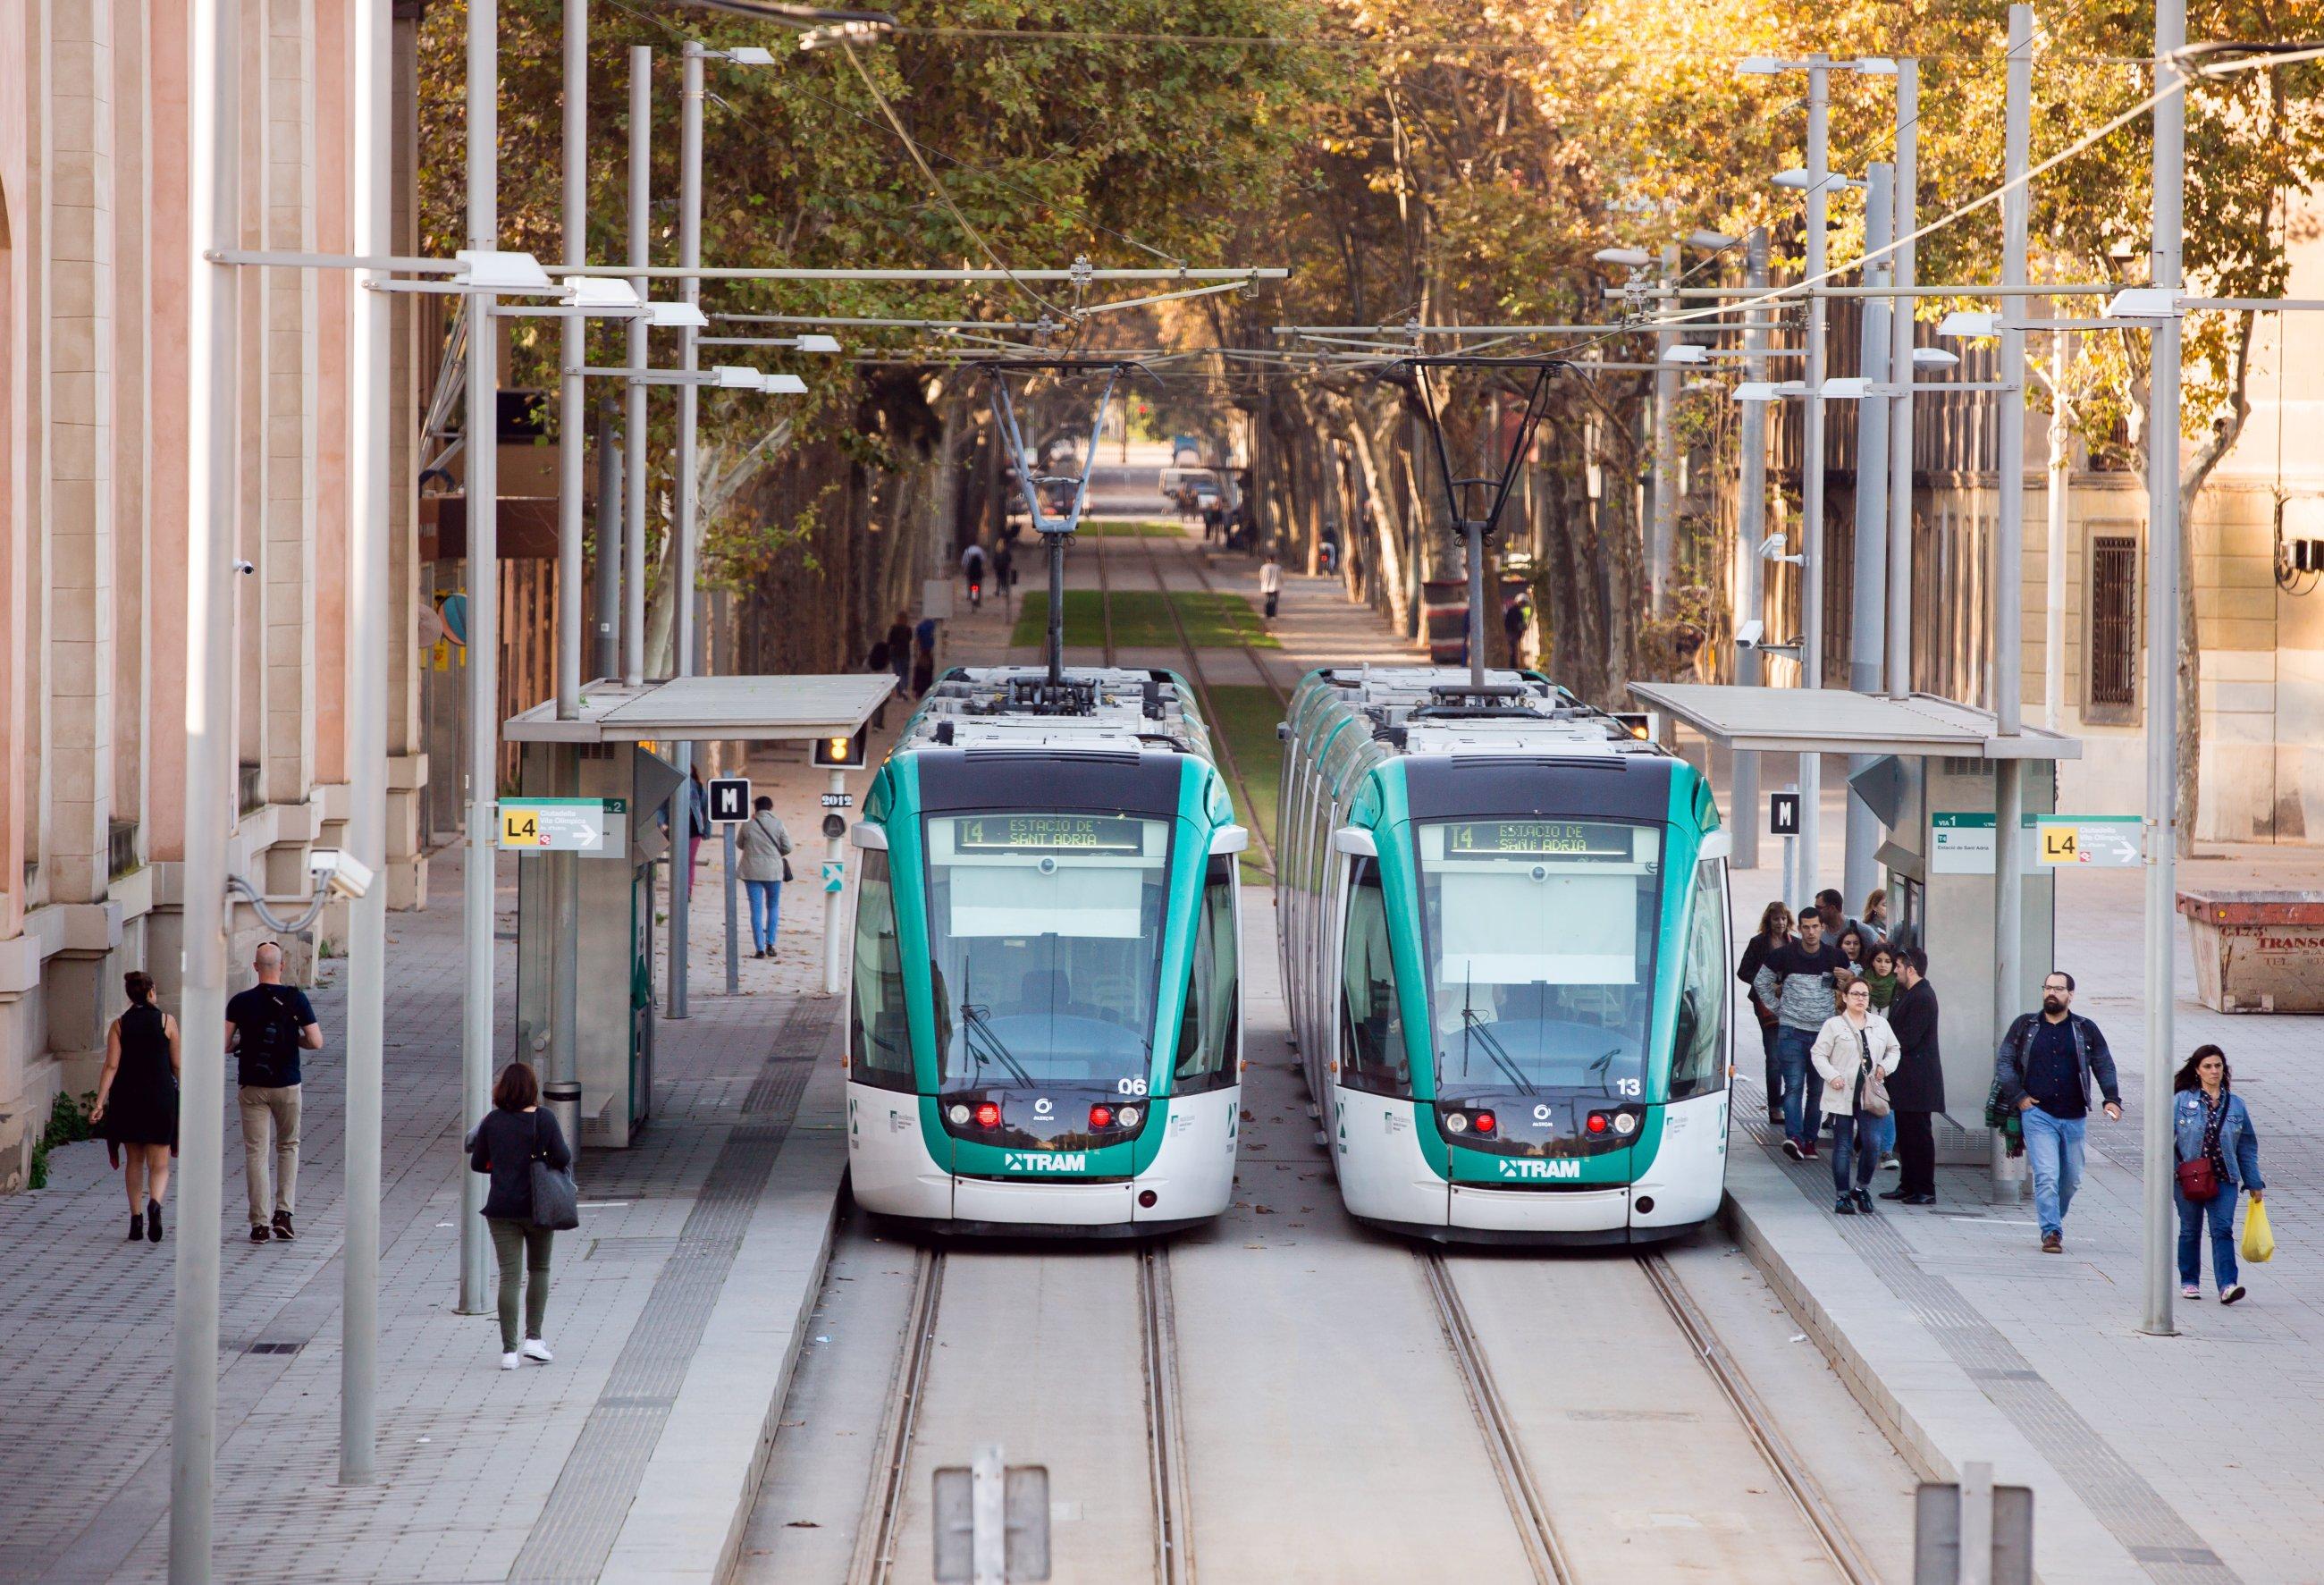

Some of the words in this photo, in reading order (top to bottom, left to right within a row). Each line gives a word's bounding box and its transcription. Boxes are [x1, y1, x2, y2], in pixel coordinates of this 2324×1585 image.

[613, 801, 622, 812] 2
[722, 788, 737, 813] M
[821, 795, 852, 806] 2012
[1779, 801, 1791, 826] M
[1950, 815, 1956, 826] 1
[508, 818, 535, 837] L4
[1009, 820, 1071, 832] ESTACIO
[1076, 820, 1094, 832] DE
[1566, 826, 1583, 838] DE
[1009, 833, 1047, 845] SANT
[1053, 833, 1097, 846] ADRIA
[1542, 839, 1587, 851] ADRIA
[2048, 835, 2076, 854] L4
[1117, 1078, 1147, 1096] 06
[1616, 1078, 1641, 1096] 13
[1023, 1154, 1085, 1171] TRAM
[1518, 1160, 1580, 1178] TRAM
